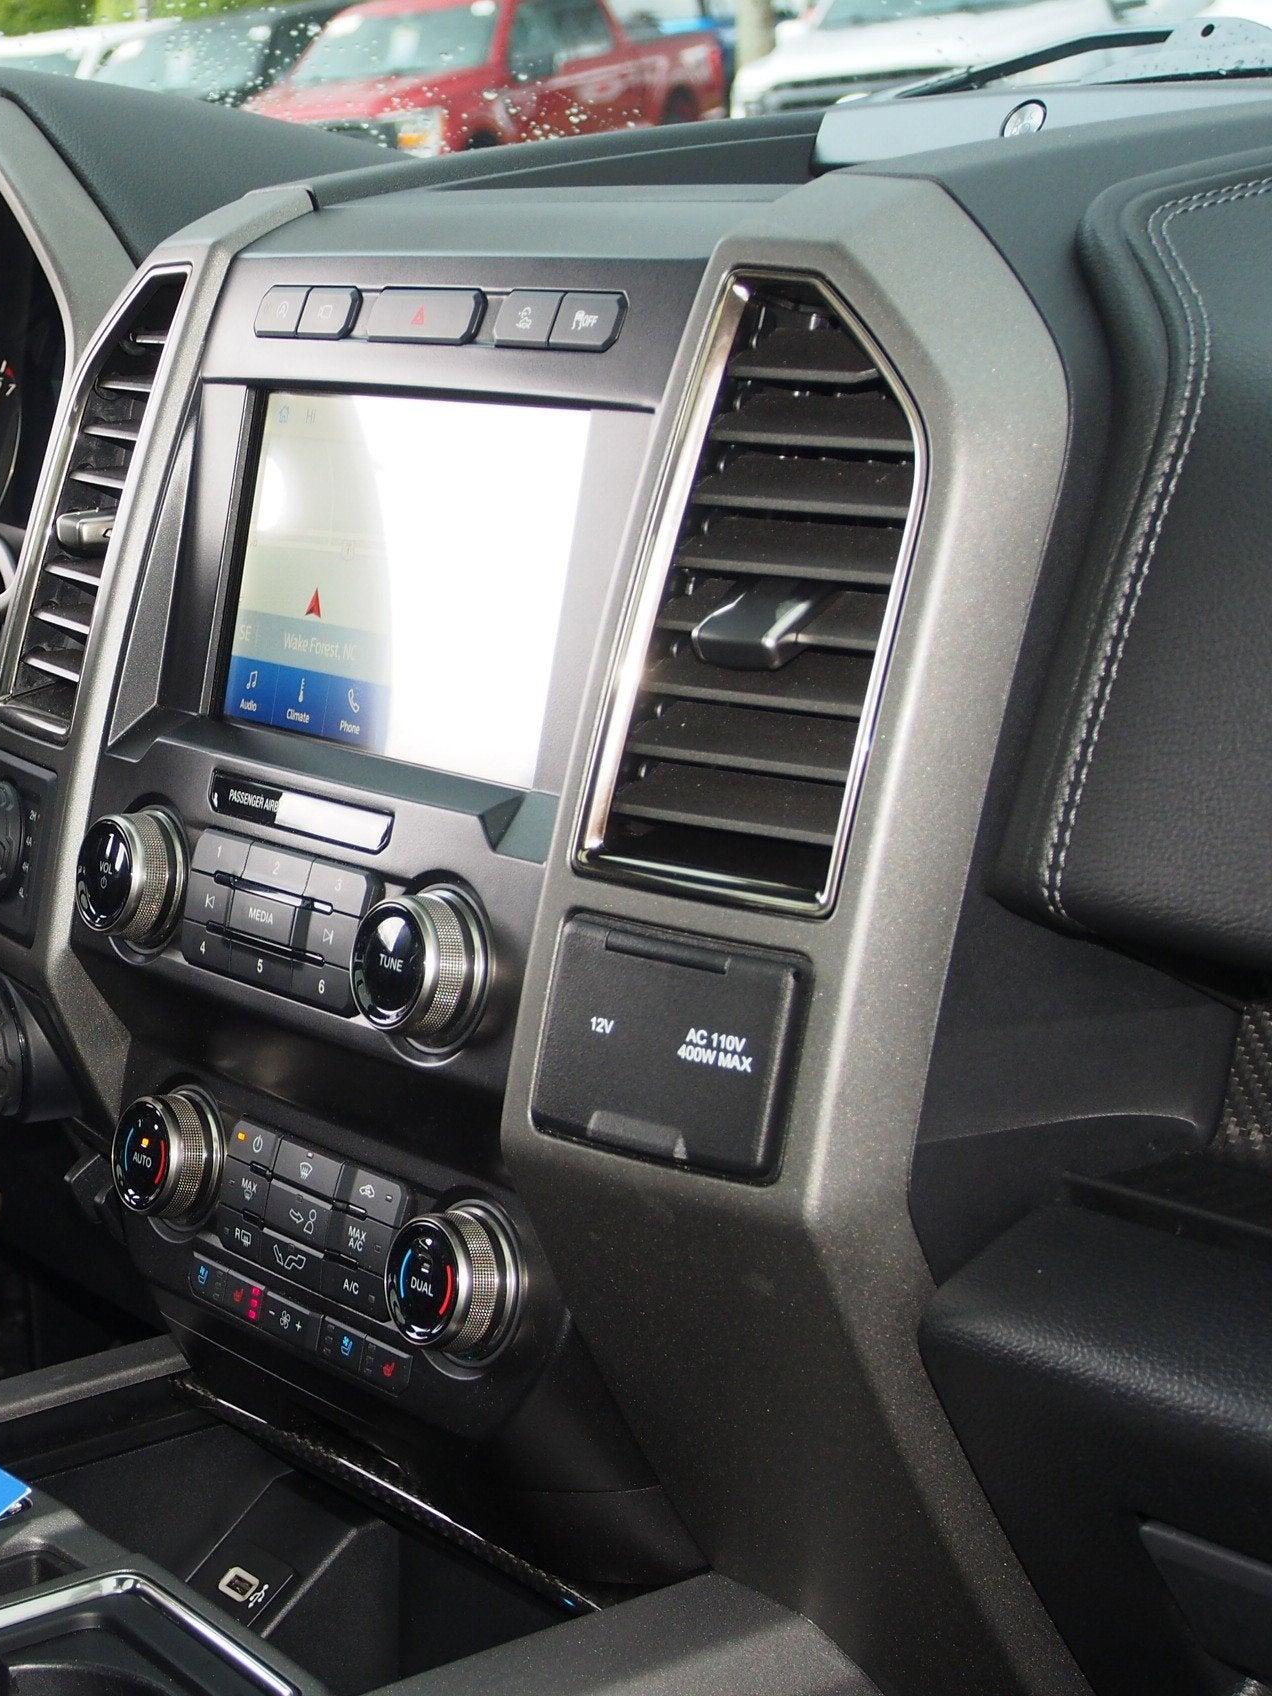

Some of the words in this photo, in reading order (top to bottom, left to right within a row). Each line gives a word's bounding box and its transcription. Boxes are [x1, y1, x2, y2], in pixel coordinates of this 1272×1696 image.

[582, 315, 598, 327] OFF
[5, 383, 17, 396] 7
[239, 624, 252, 641] SE
[283, 632, 308, 653] Wake
[309, 637, 341, 661] Forest,
[342, 644, 358, 661] NC
[239, 698, 257, 712] Audio
[286, 708, 310, 723] Climate
[339, 720, 361, 735] Phone
[228, 788, 264, 808] PASSENGER
[217, 844, 223, 858] 1
[99, 860, 113, 875] VOL
[272, 860, 280, 875] 2
[334, 878, 342, 892] 3
[248, 907, 274, 925] MEDIA
[199, 940, 206, 955] 4
[256, 958, 264, 973] 5
[379, 953, 404, 972] TUNE
[318, 979, 325, 994] 6
[590, 1016, 615, 1034] 12V
[685, 1028, 708, 1045] AC
[710, 1033, 747, 1053] 110V
[677, 1043, 717, 1065] 400W
[717, 1051, 753, 1073] MAX
[132, 1151, 153, 1168] AUTO
[241, 1177, 258, 1193] MAX
[348, 1225, 367, 1242] MAX
[348, 1237, 364, 1252] A/C
[342, 1278, 360, 1295] A/C
[410, 1276, 434, 1298] DUAL
